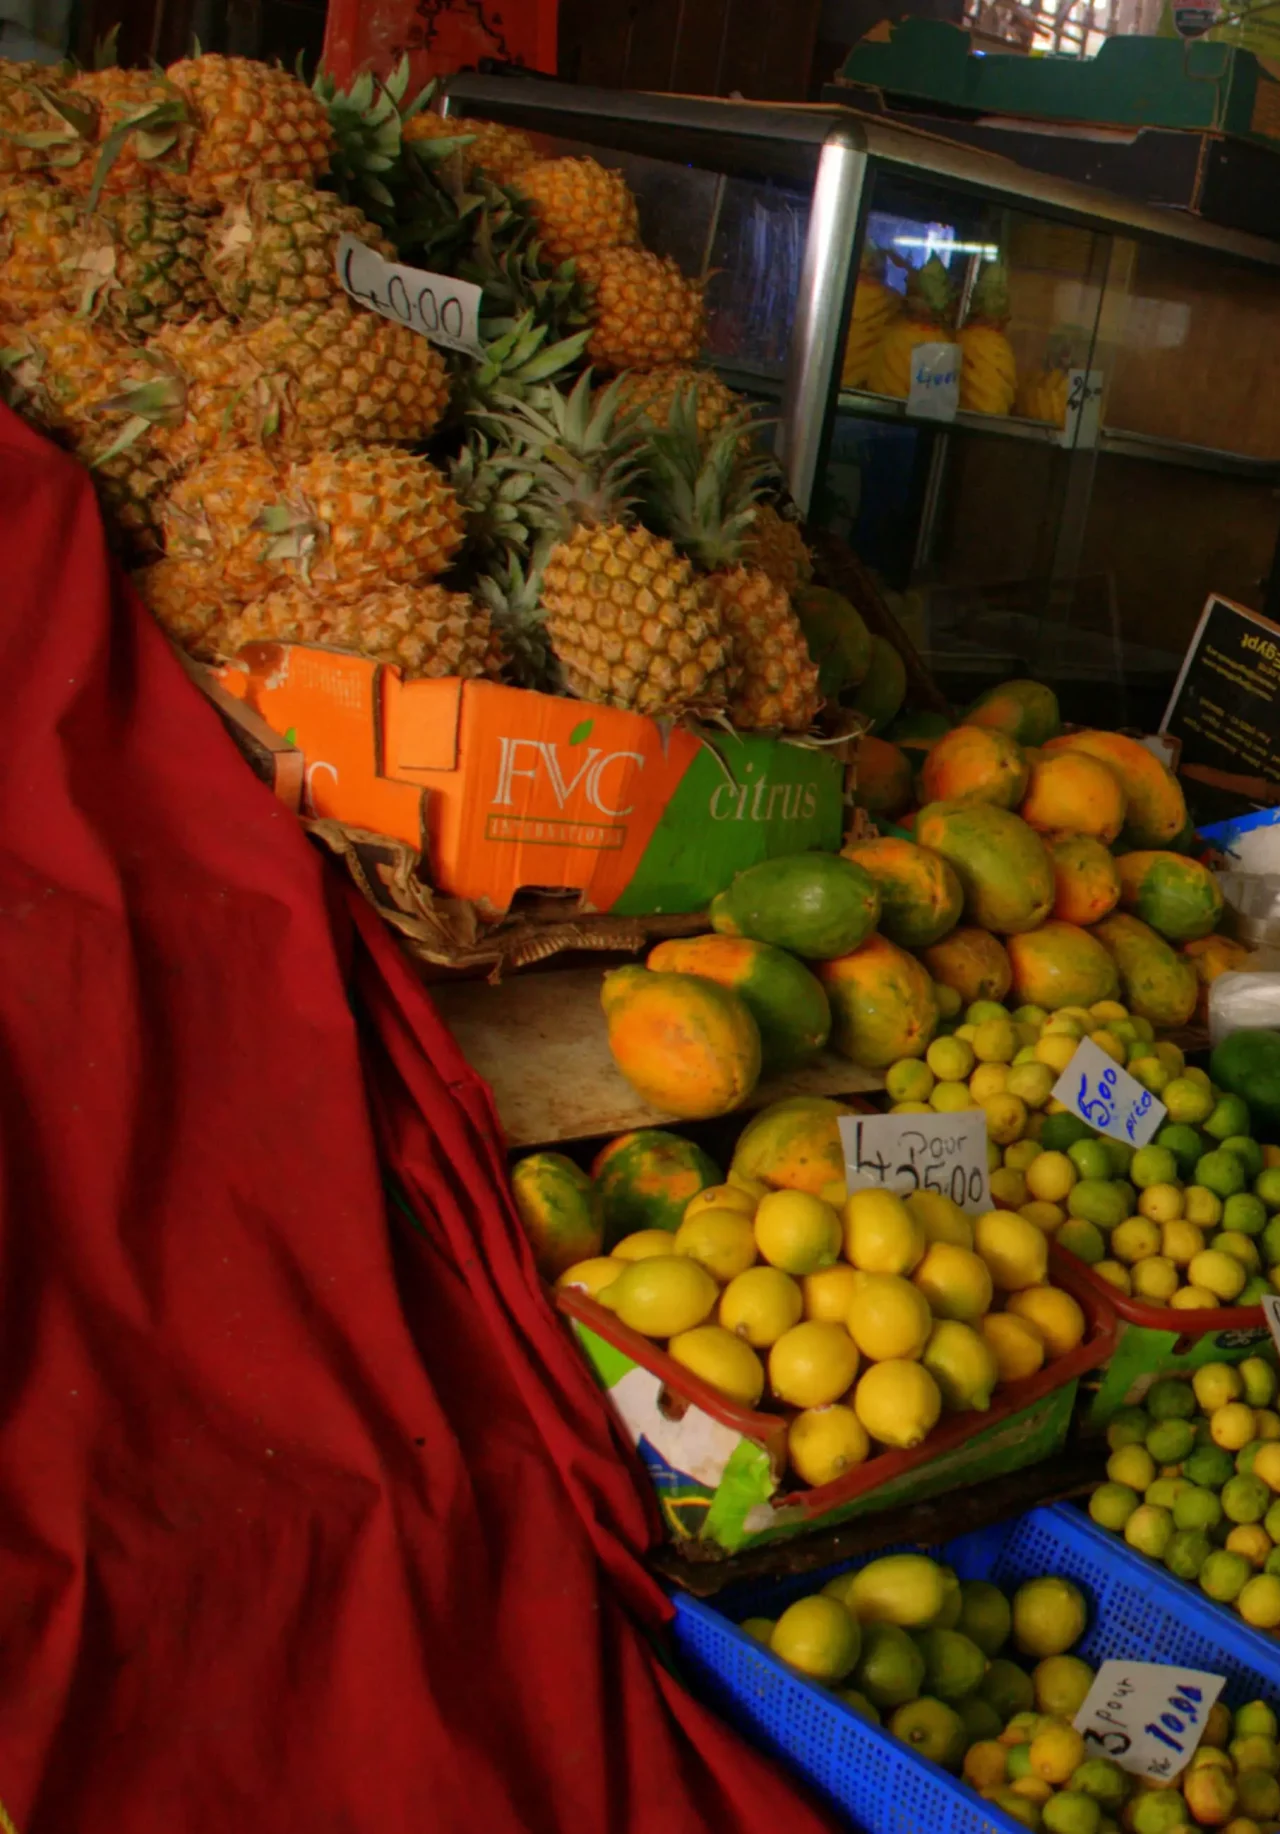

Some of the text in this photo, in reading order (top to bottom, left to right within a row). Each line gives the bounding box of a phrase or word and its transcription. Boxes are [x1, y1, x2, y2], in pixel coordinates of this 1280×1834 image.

[492, 736, 645, 817] FVC
[709, 762, 818, 822] citrus
[857, 1121, 892, 1181] 4
[1083, 1677, 1135, 1755] 3 pour
